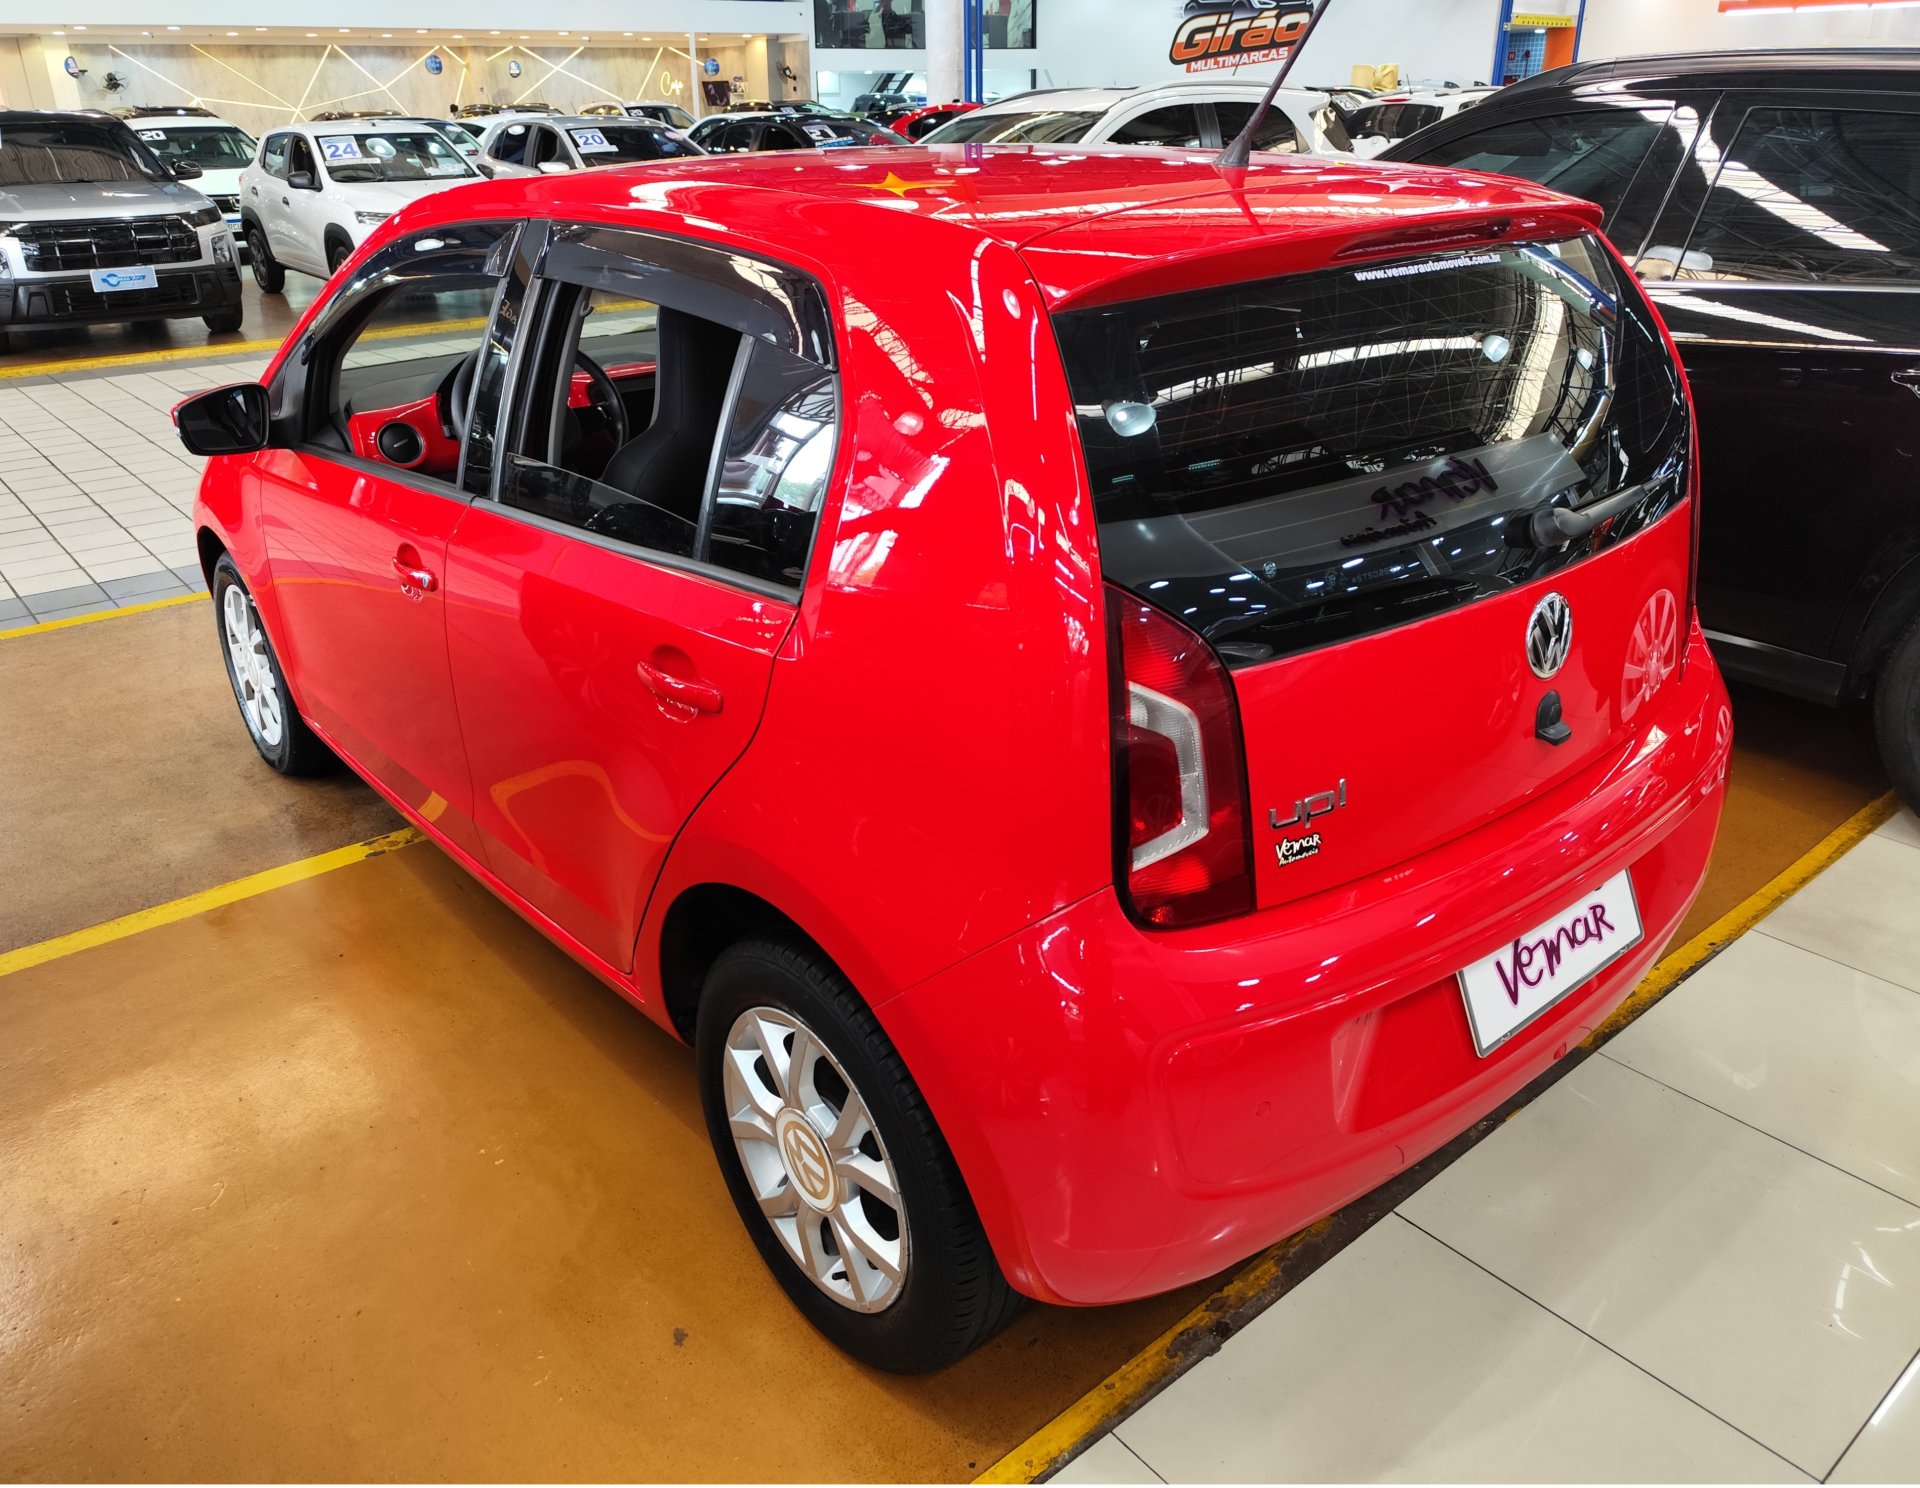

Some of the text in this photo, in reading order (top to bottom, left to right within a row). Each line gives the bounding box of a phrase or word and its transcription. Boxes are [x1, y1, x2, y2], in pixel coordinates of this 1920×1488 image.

[1190, 47, 1289, 72] MULTIMARCAS
[579, 134, 605, 146] 20
[326, 143, 358, 159] 24
